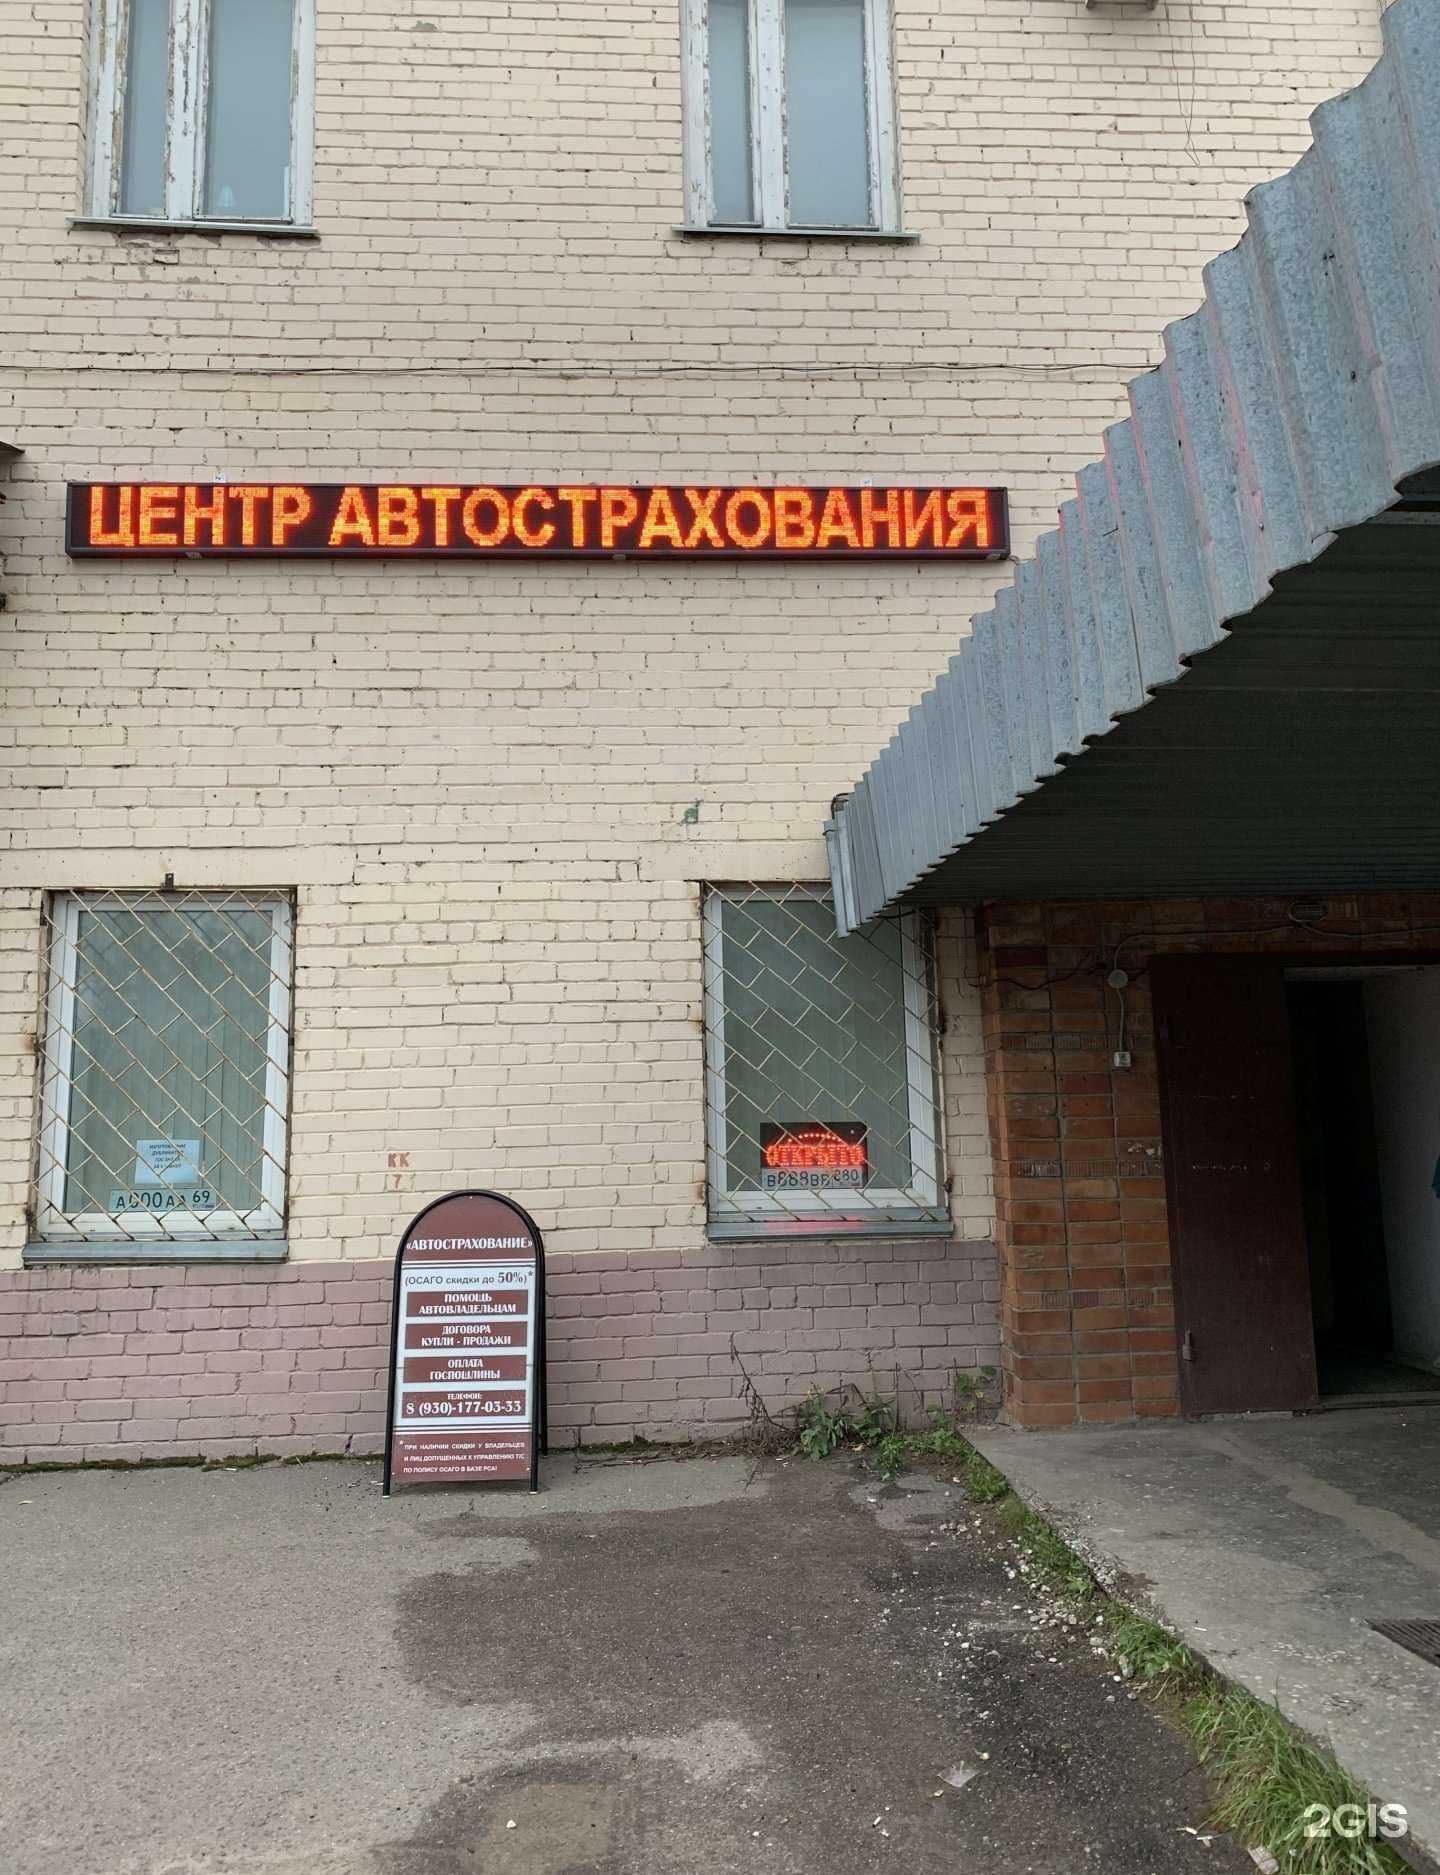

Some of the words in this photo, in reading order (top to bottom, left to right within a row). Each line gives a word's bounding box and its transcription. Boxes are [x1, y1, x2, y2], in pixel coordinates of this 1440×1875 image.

[90, 486, 311, 546] ЦЕНТР
[328, 486, 988, 547] АВТОСТРАХОВАНИЯ
[193, 1190, 210, 1203] 69
[406, 1237, 532, 1250] «АВТОСТРАХОВАНИЕ»
[405, 1275, 443, 1286] (ОСАГО
[446, 1276, 479, 1285] скидки
[482, 1276, 495, 1284] до
[444, 1293, 492, 1302] ПОМОЩЬ
[419, 1304, 516, 1314] АВТОВЛАДЕЛЬЦАМ
[442, 1325, 491, 1335] ДОГОВОРА
[421, 1337, 454, 1346] КУПЛИ
[463, 1336, 511, 1346] ПРОДАЖИ
[448, 1359, 483, 1368] ОПЛАТА
[430, 1370, 500, 1380] ГОСПОШЛИНЫ
[407, 1402, 415, 1414] 8
